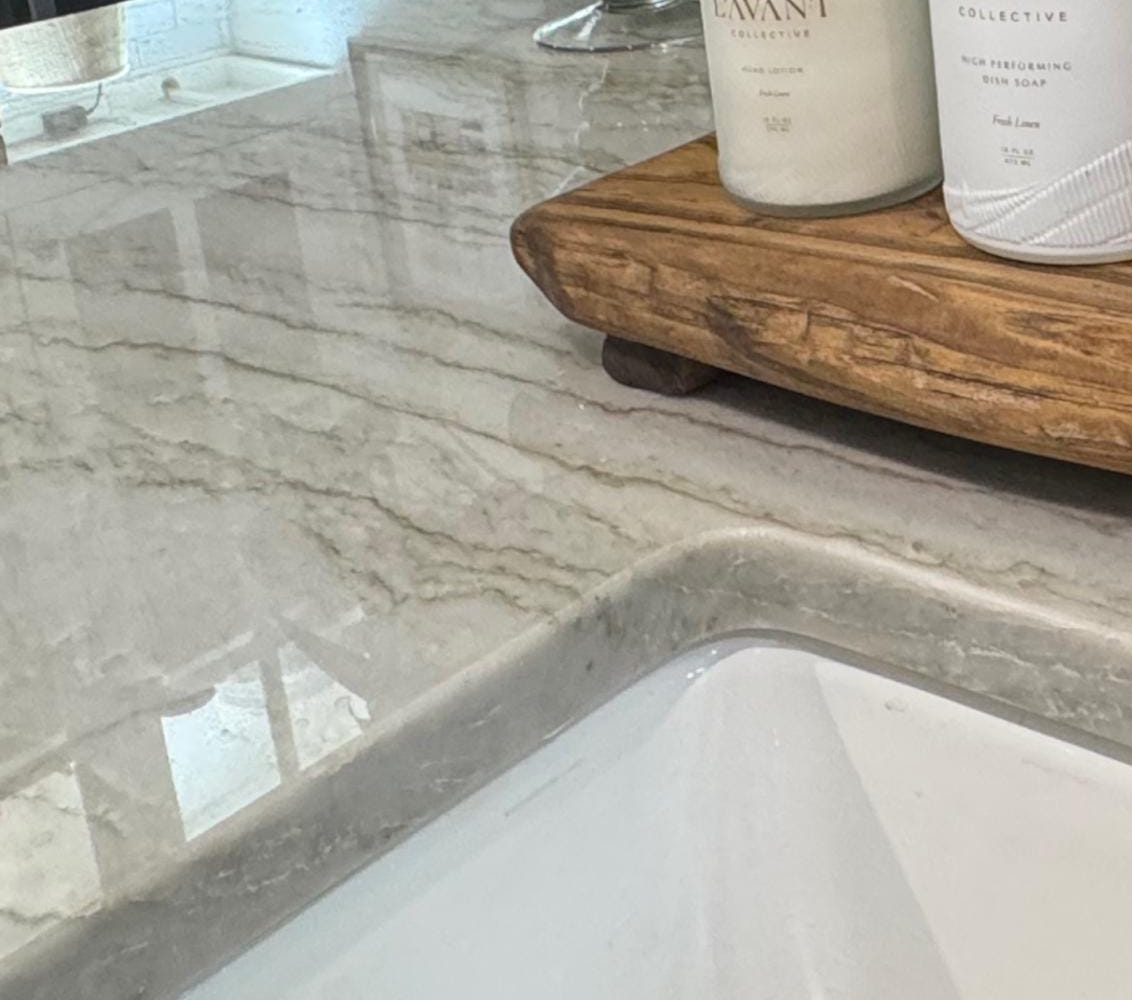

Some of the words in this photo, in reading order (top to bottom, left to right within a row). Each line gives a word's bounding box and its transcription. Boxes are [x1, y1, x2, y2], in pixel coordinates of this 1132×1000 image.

[958, 6, 1068, 23] COLLECTIVE
[731, 29, 810, 40] COLLECTIVE
[961, 55, 987, 67] HIGH
[990, 59, 1073, 72] PERFORMING
[982, 74, 1009, 87] DISH
[1014, 78, 1048, 89] SOAP
